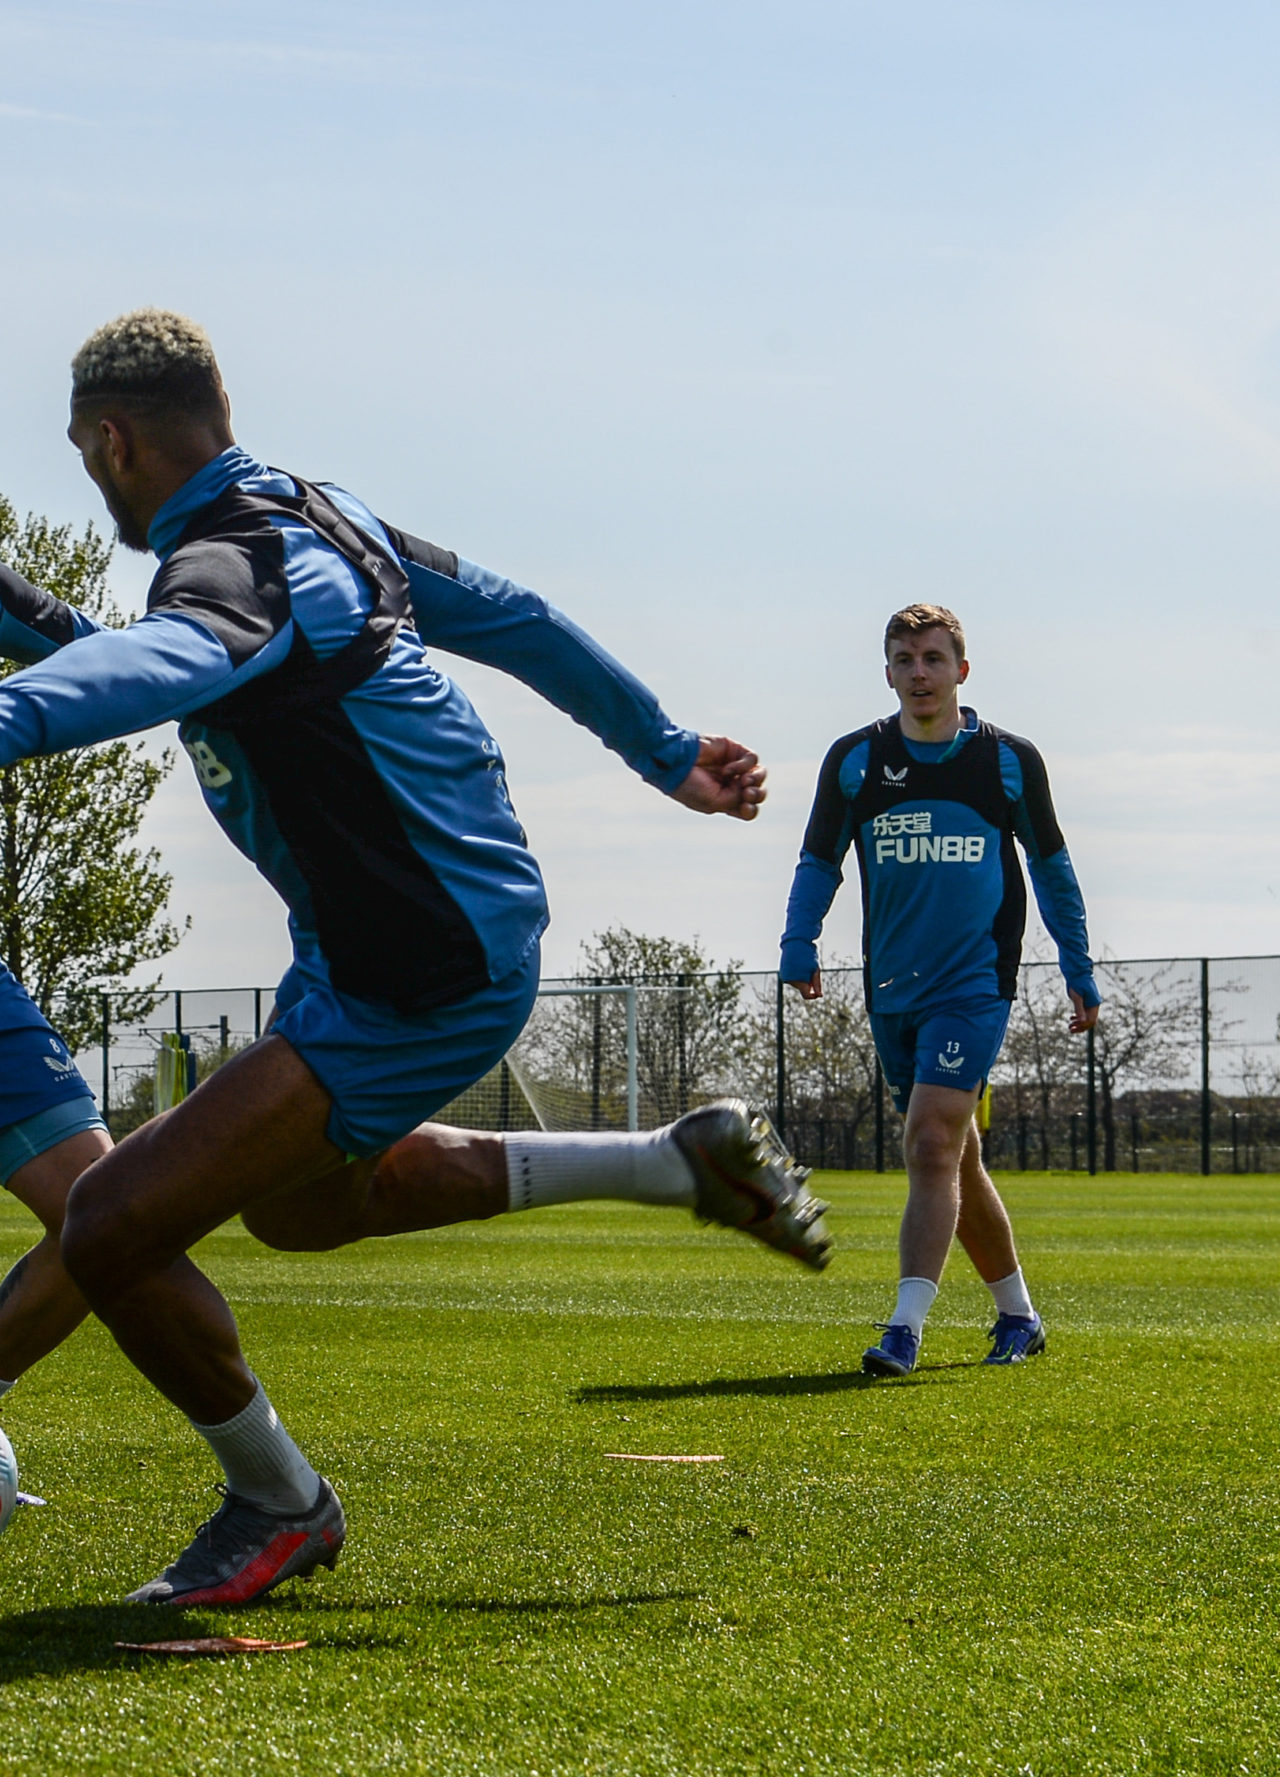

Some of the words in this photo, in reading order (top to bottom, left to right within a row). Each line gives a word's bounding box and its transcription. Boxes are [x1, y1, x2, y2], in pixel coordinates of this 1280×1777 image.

[872, 811, 932, 836] 乐天堂
[875, 835, 985, 864] FUN88
[49, 1038, 61, 1053] 8
[946, 1041, 960, 1054] 13
